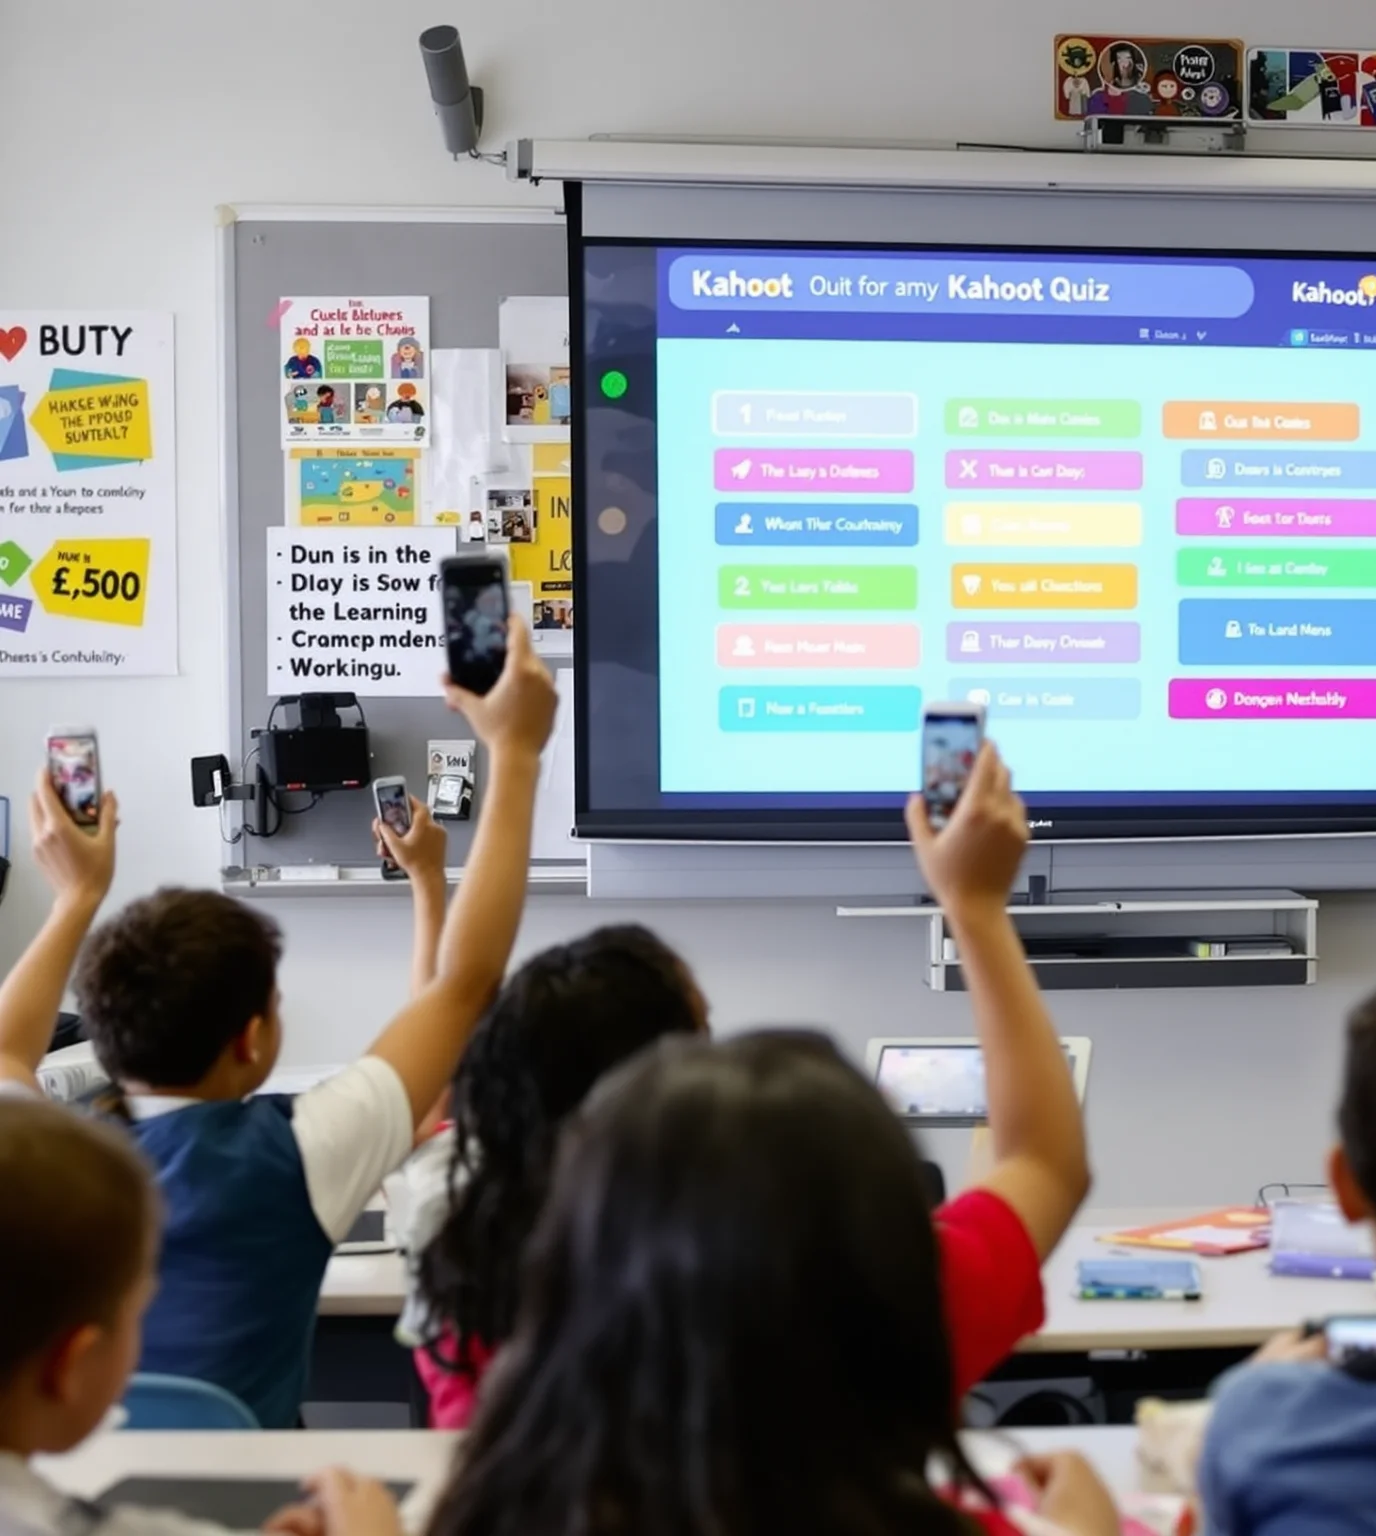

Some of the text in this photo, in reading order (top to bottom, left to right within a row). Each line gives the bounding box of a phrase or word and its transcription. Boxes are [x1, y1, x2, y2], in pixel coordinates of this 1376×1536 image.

[692, 270, 794, 298] Kahoot
[858, 275, 890, 297] for
[894, 279, 940, 302] amy
[948, 275, 1045, 302] Kahoot
[1049, 276, 1111, 303] Quiz
[39, 324, 133, 356] BUTY
[60, 415, 85, 430] THE
[291, 545, 432, 564] Dun is in the
[52, 566, 141, 602] £,500
[352, 574, 370, 592] is
[376, 573, 421, 592] Sow
[289, 602, 428, 625] the Learning
